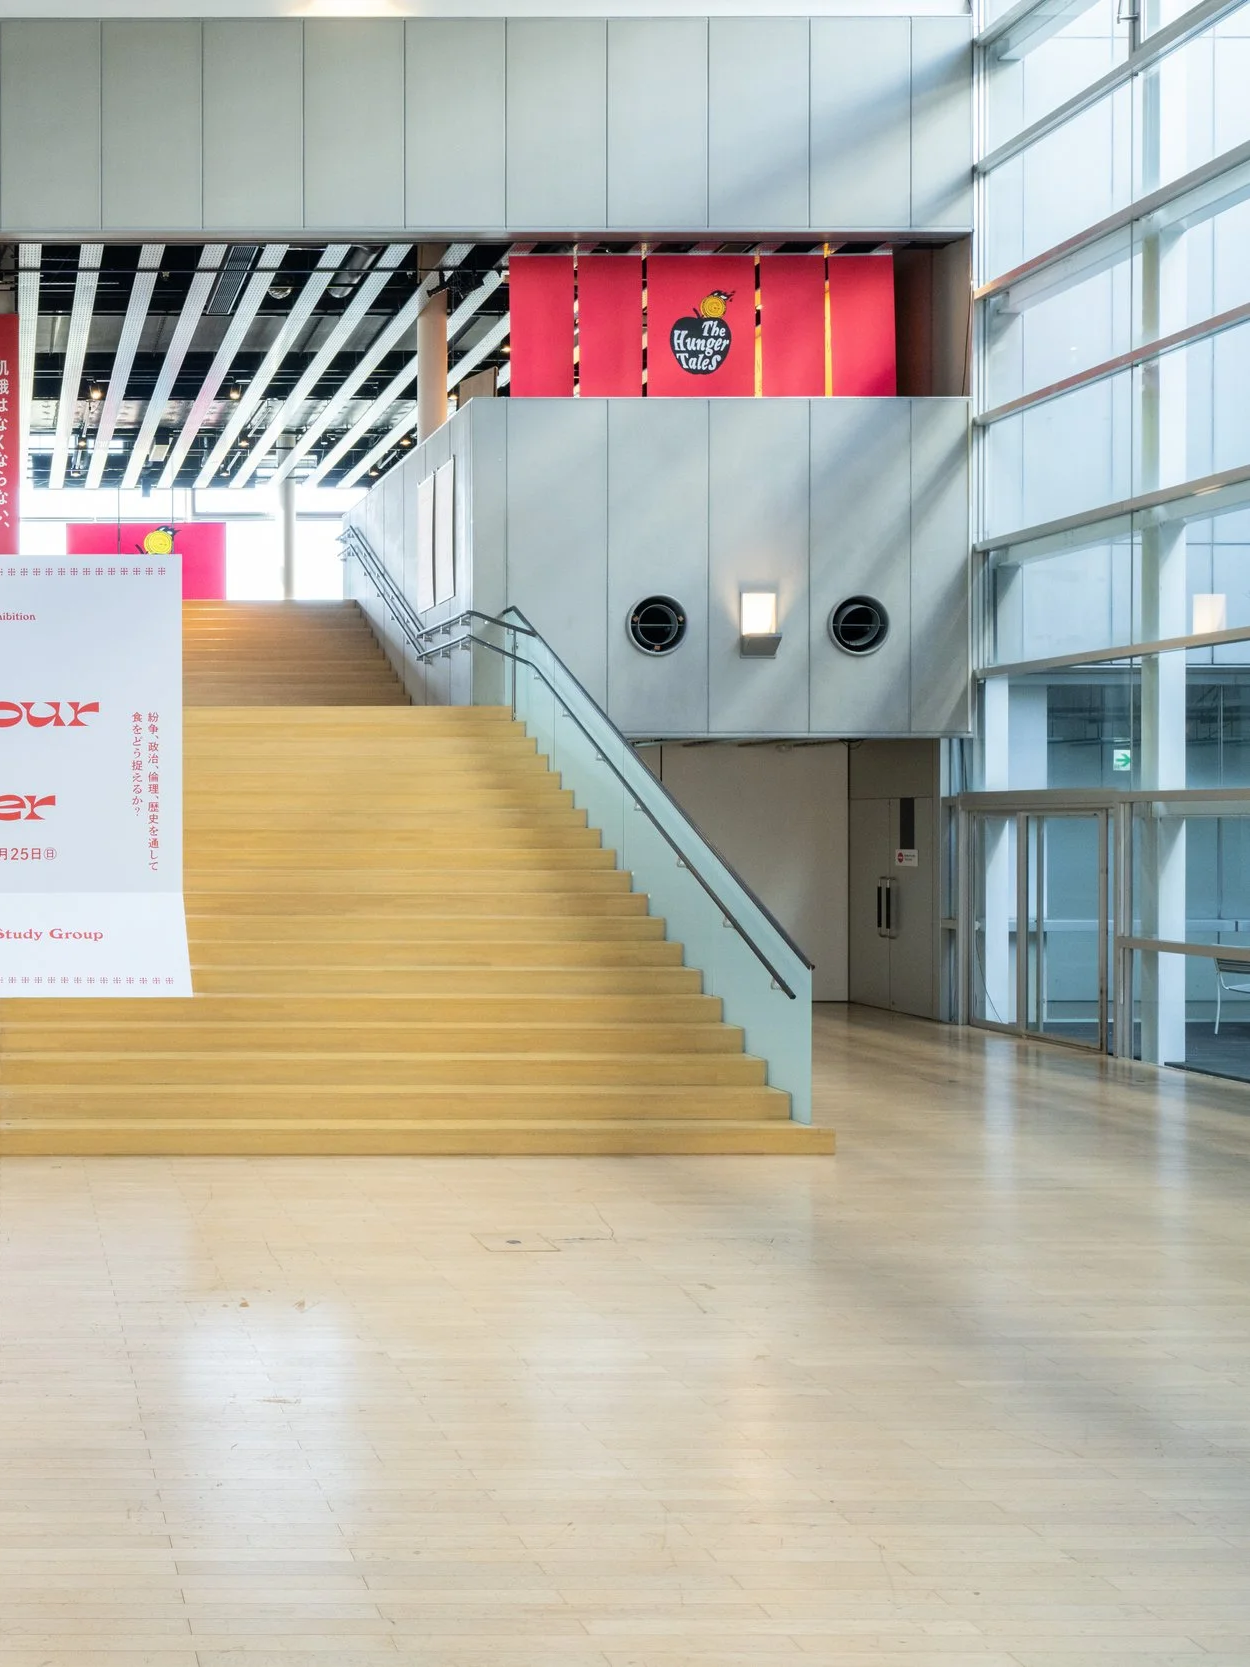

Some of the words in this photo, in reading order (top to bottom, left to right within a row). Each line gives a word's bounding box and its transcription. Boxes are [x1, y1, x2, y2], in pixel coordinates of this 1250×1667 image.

[702, 321, 726, 337] The
[673, 330, 730, 357] Hunger
[675, 352, 722, 371] Tales
[48, 928, 104, 942] Group
